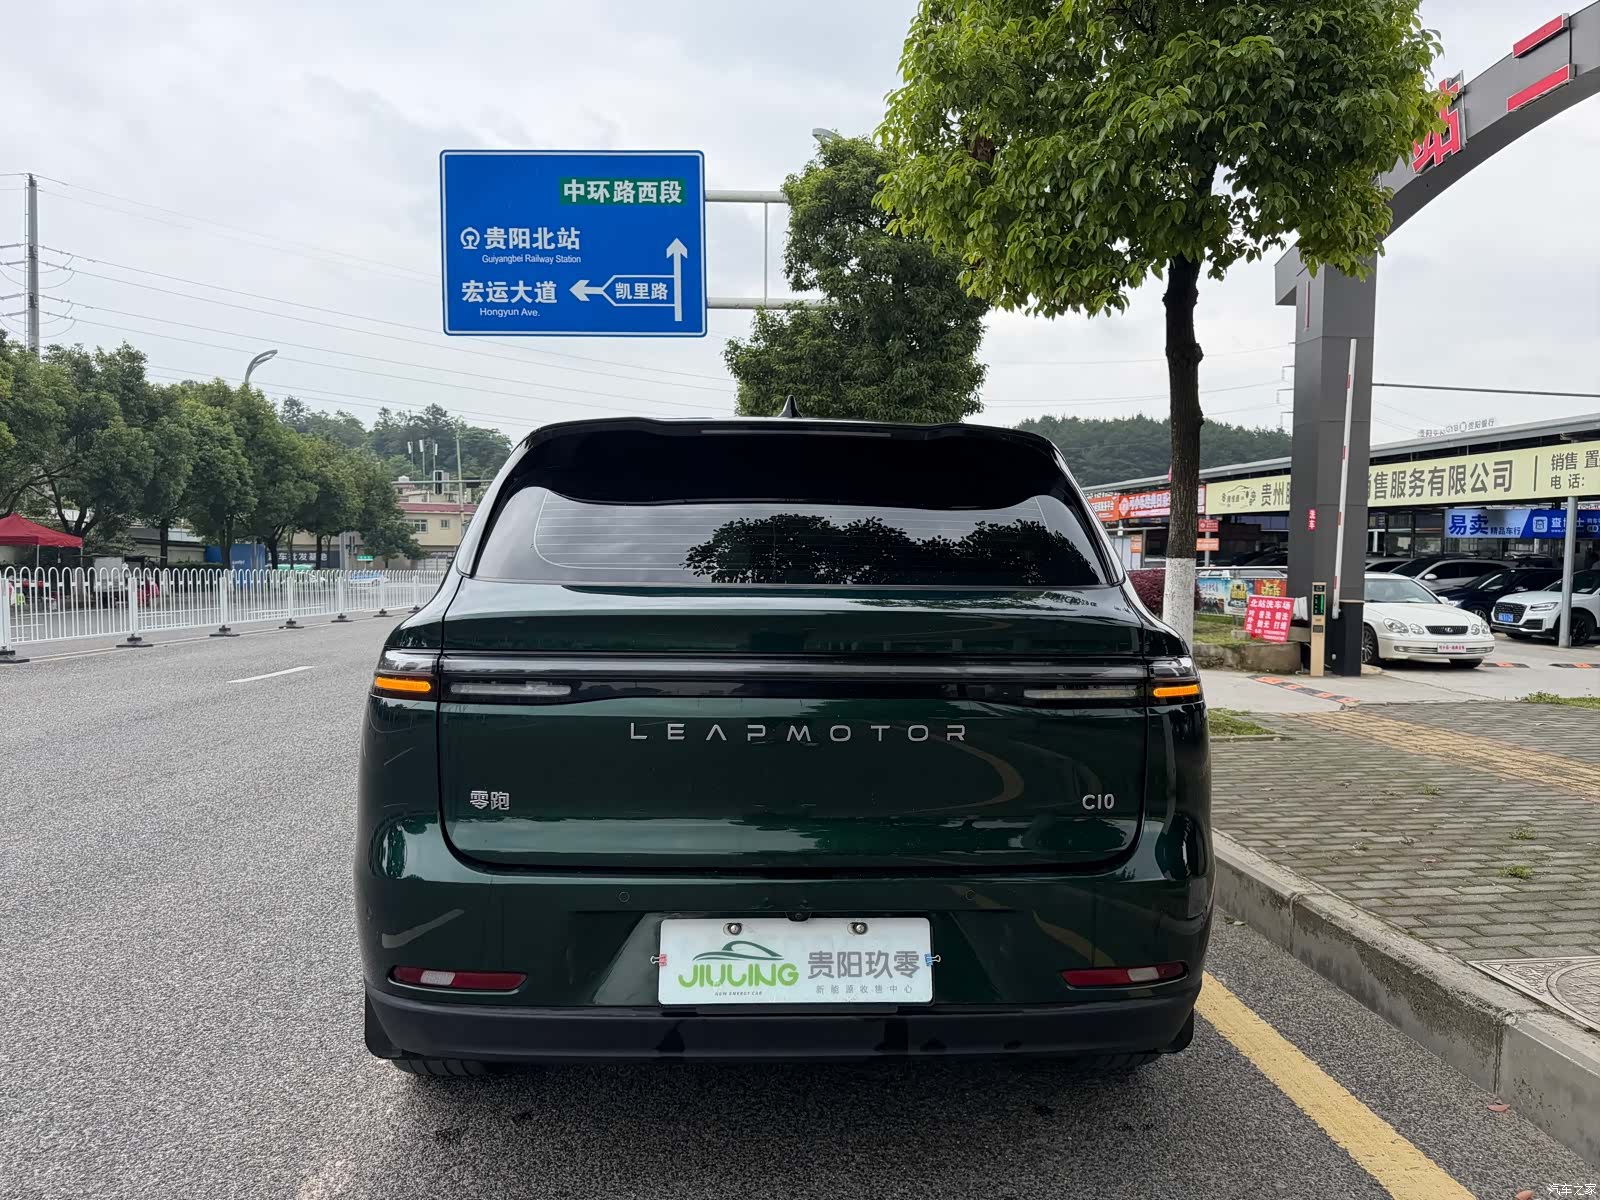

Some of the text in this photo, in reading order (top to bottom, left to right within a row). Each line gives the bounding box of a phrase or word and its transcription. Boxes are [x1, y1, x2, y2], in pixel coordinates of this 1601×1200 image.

[563, 178, 683, 204] 中环路西段
[484, 226, 581, 250] 贵阳北站
[482, 254, 581, 265] Guiyangbei Railway Station
[461, 280, 558, 304] 宏运大道
[615, 282, 669, 301] 凯里路
[480, 307, 541, 318] Hongyun Ave.
[1551, 452, 1578, 472] 销售
[1449, 514, 1521, 536] 易卖 精品车行
[630, 722, 967, 743] LEAPMOTOR
[469, 790, 510, 811] 零跑
[1082, 793, 1115, 811] C10
[677, 962, 800, 989] JIULING
[807, 950, 920, 980] 贵阳玖零
